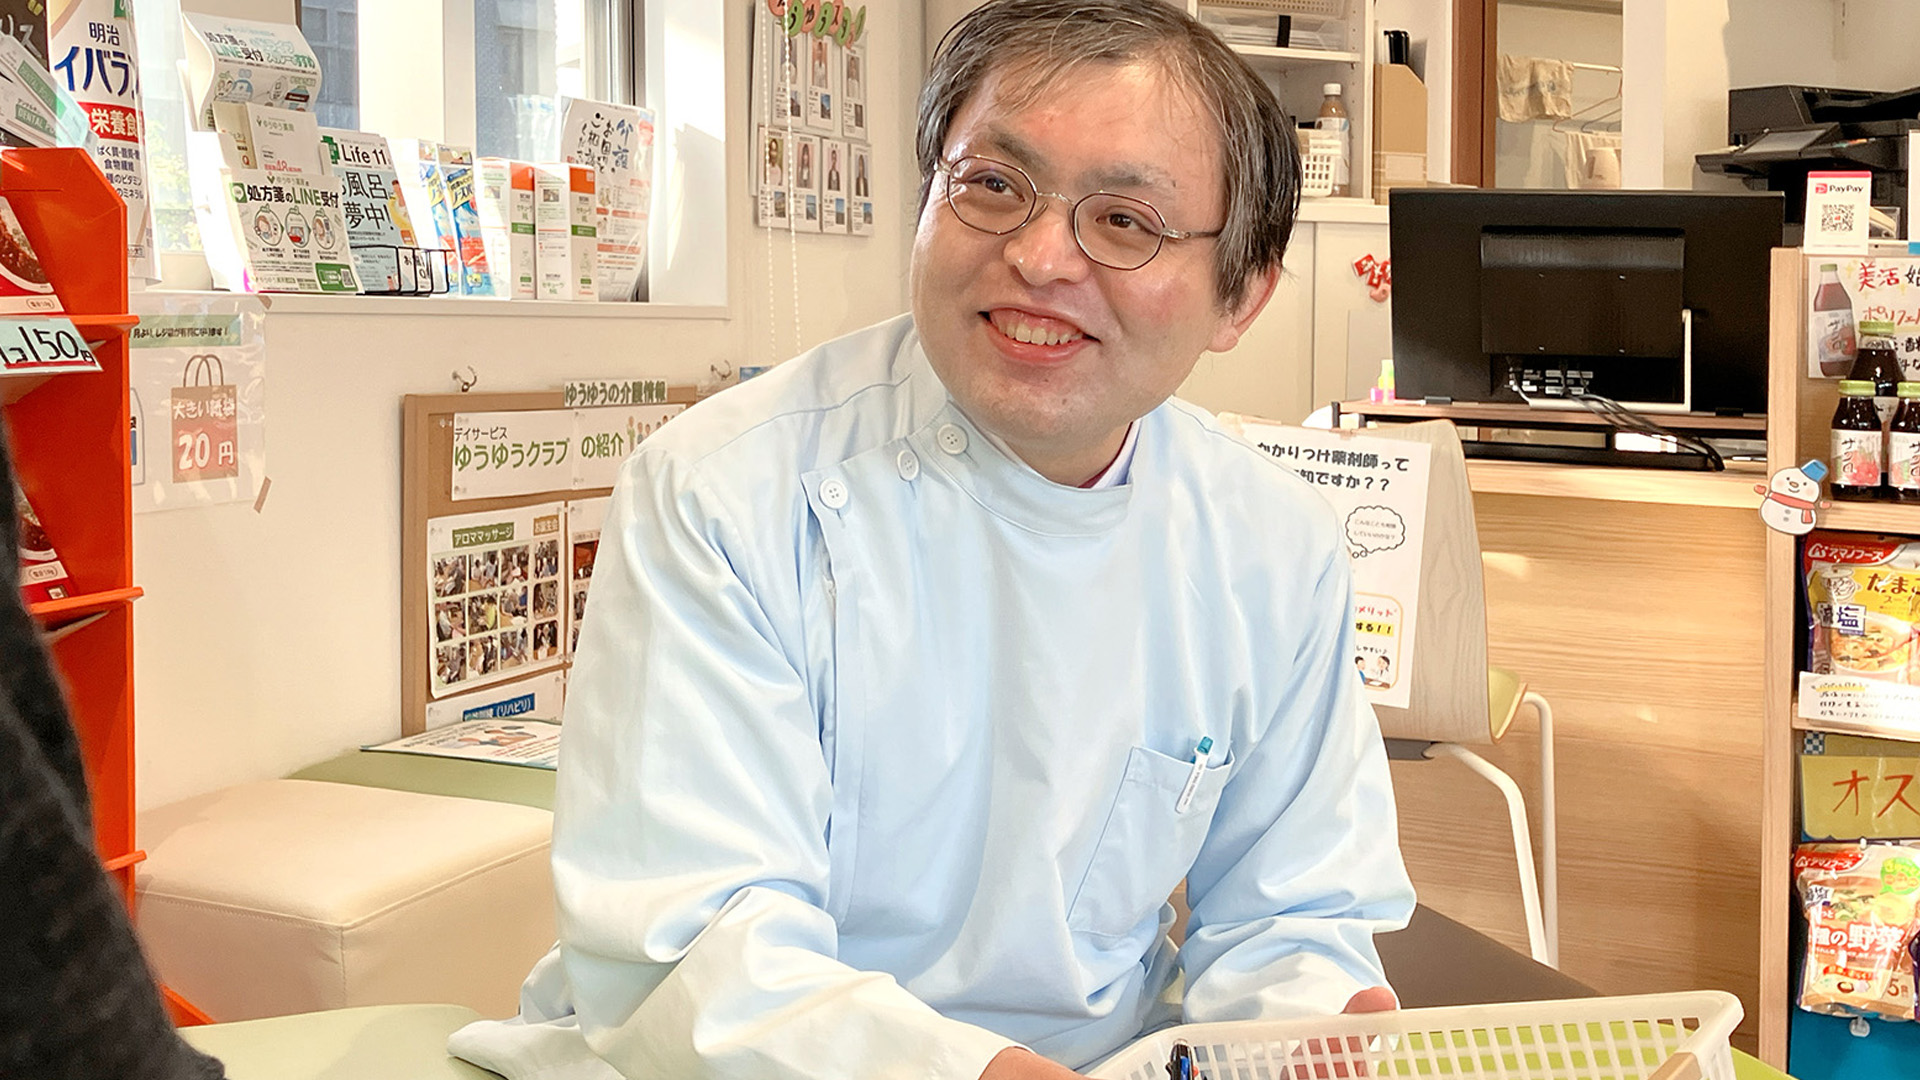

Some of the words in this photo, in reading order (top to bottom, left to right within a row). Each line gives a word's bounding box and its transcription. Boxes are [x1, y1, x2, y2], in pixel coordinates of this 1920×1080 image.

[89, 22, 120, 46] 明治
[341, 144, 371, 163] Life
[372, 149, 387, 165] 11
[247, 185, 339, 208] 処方箋のLINE受付
[1829, 184, 1864, 195] PayPay
[1859, 262, 1899, 292] 美活
[565, 381, 667, 406] ゆうゆうの介護情報
[173, 398, 236, 420] 大きい紙袋
[454, 426, 508, 442] デイサービス
[454, 437, 571, 472] ゆうゆうクラブ
[581, 432, 625, 459] の紹介
[1294, 468, 1391, 492] 知ですか？？
[454, 526, 513, 546] アロママッサージ
[1829, 547, 1885, 561] アマノフーズ
[1355, 605, 1393, 617] メリット
